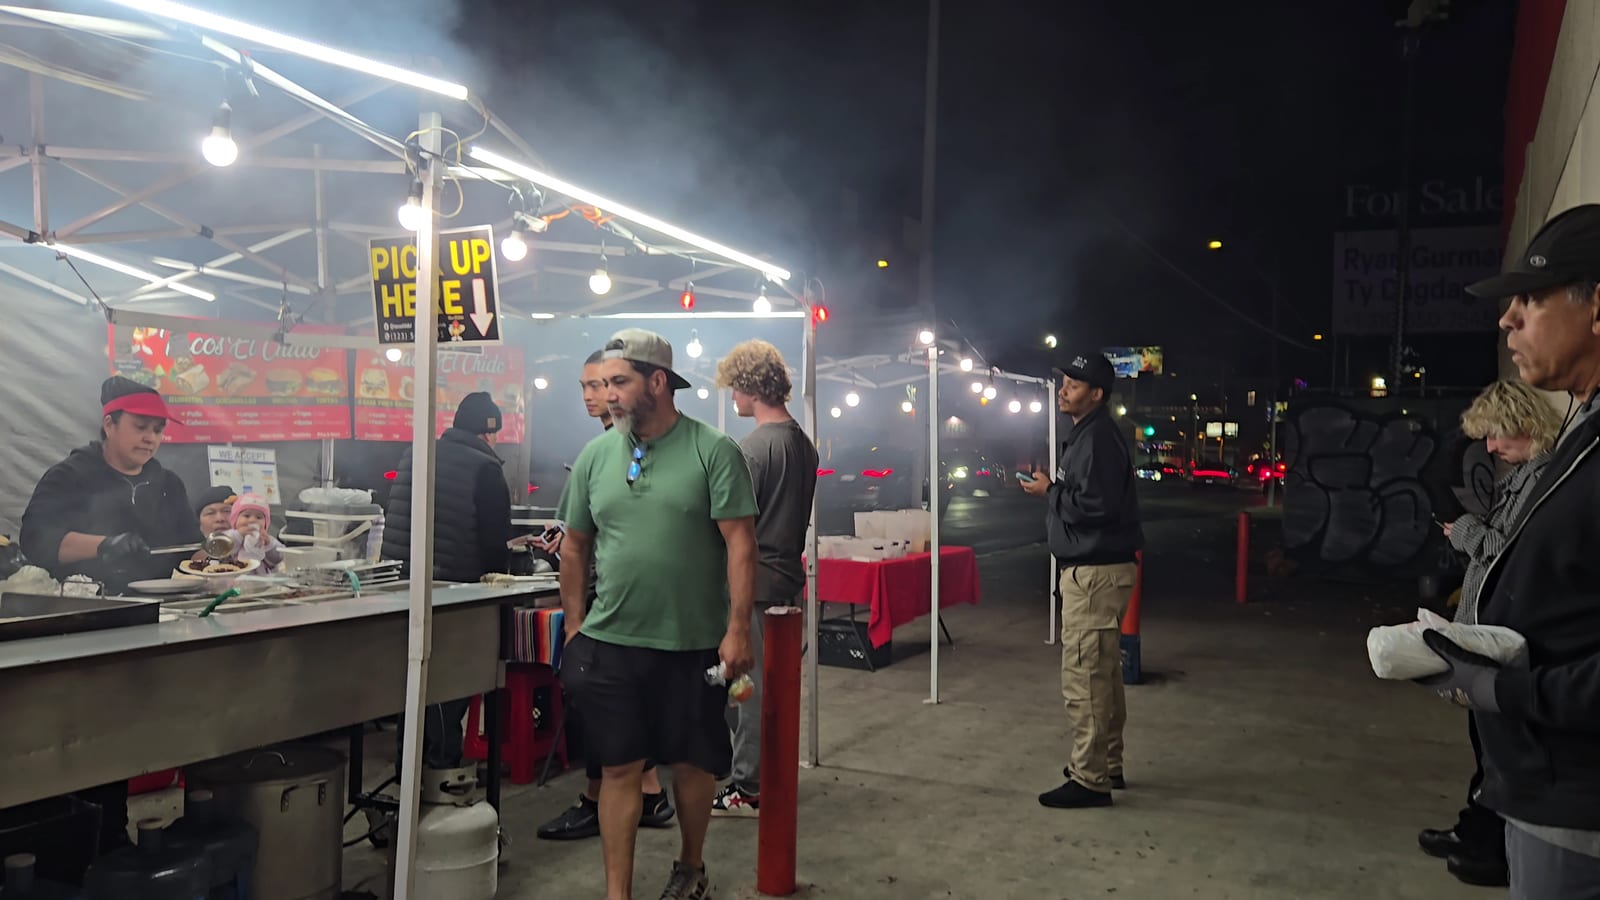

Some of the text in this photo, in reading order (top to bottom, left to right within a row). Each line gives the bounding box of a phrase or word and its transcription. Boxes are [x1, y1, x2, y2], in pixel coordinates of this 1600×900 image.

[371, 238, 491, 281] PIC UP
[380, 280, 464, 318] HEE
[1382, 276, 1477, 305] Dgda
[219, 450, 232, 460] WE
